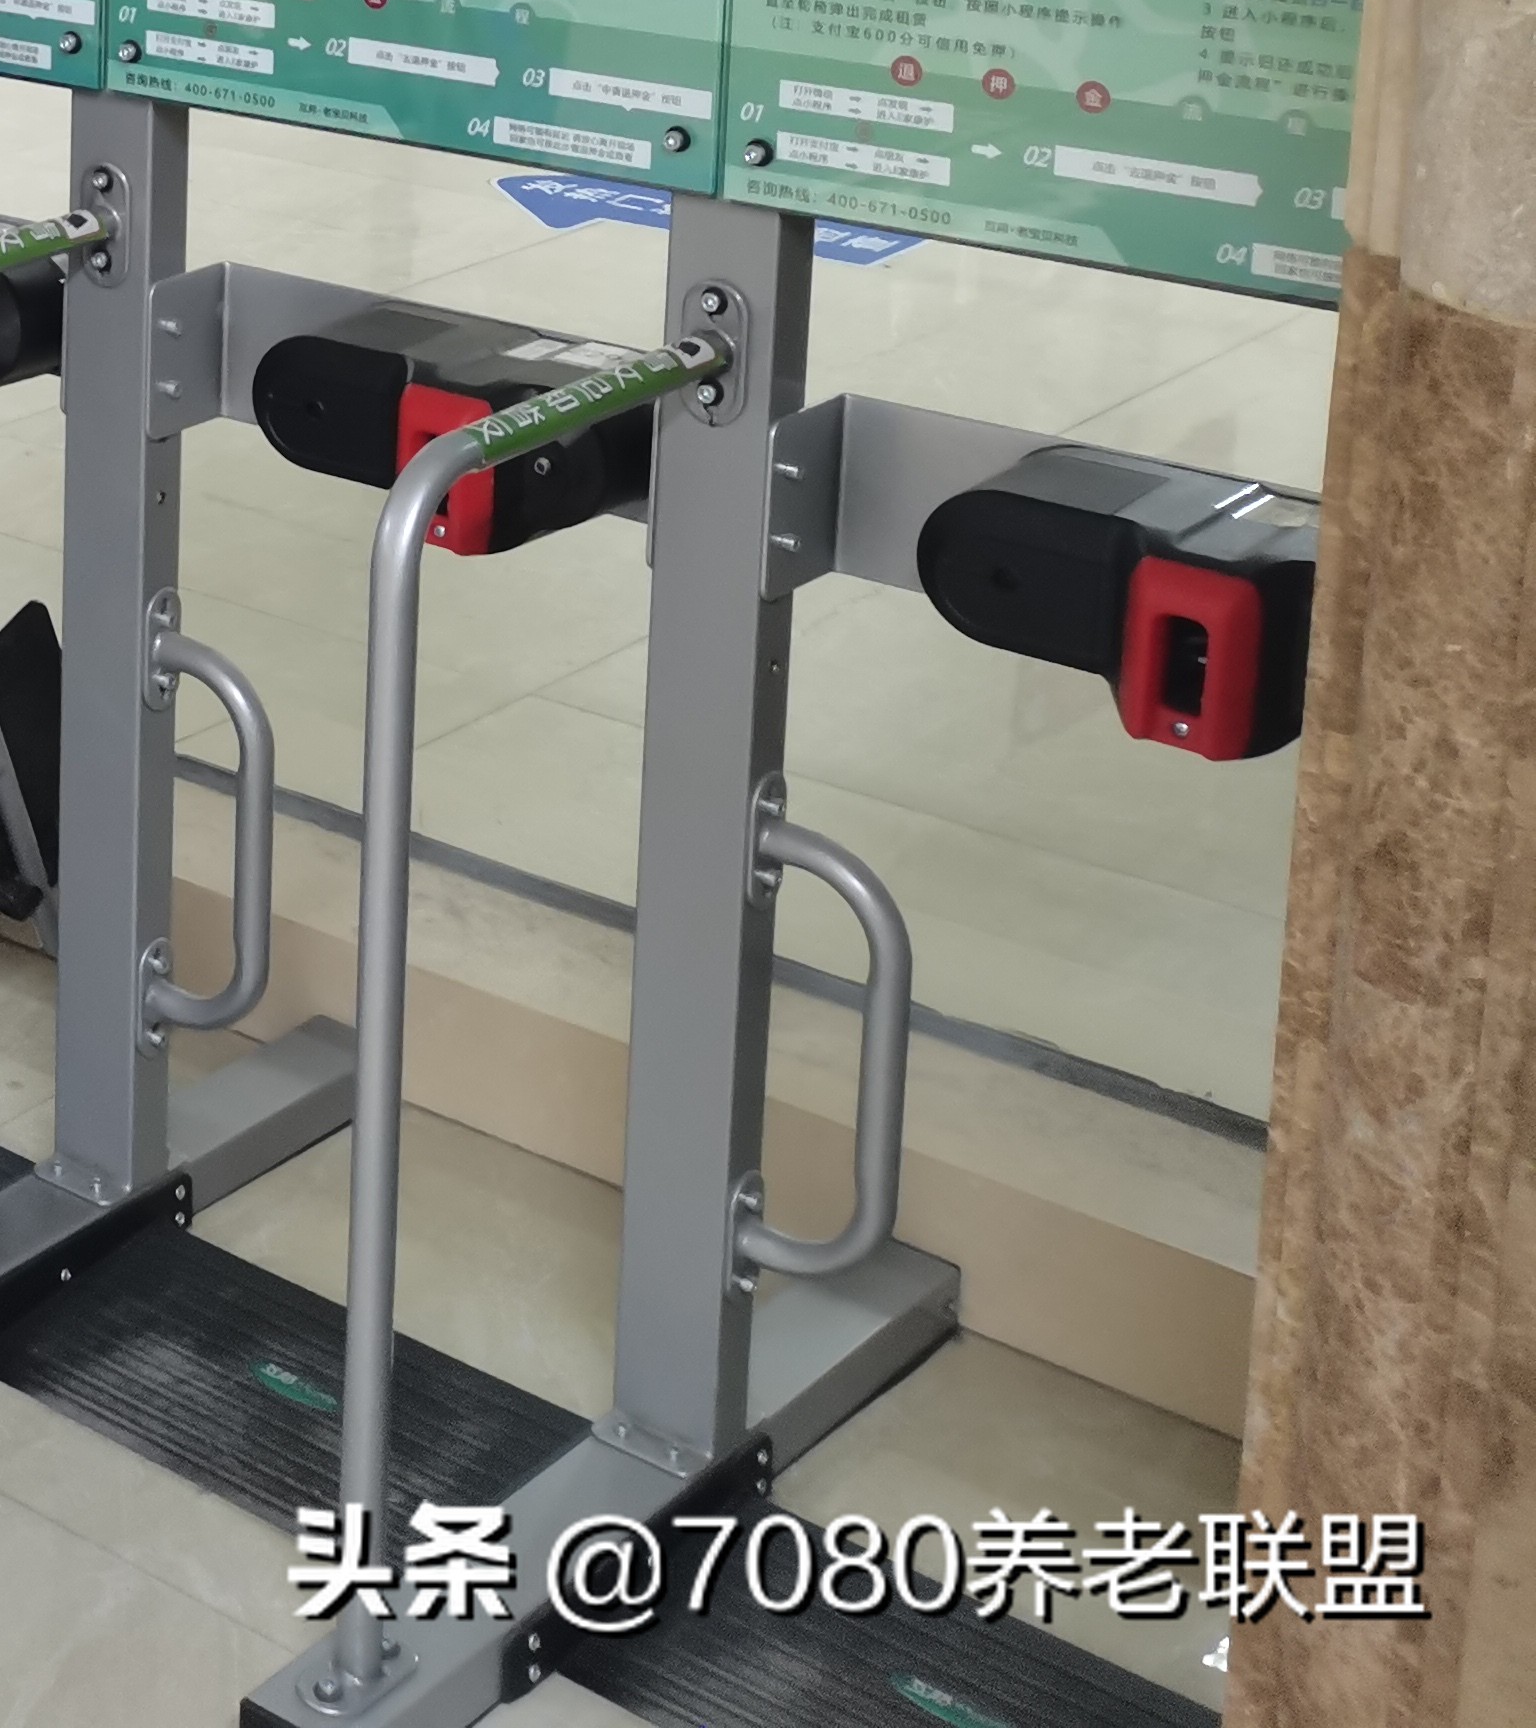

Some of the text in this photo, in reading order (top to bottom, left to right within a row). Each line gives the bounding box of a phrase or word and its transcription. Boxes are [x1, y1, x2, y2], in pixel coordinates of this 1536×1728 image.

[1023, 145, 1052, 168] 02
[1293, 187, 1327, 210] 03
[1216, 242, 1248, 265] 04
